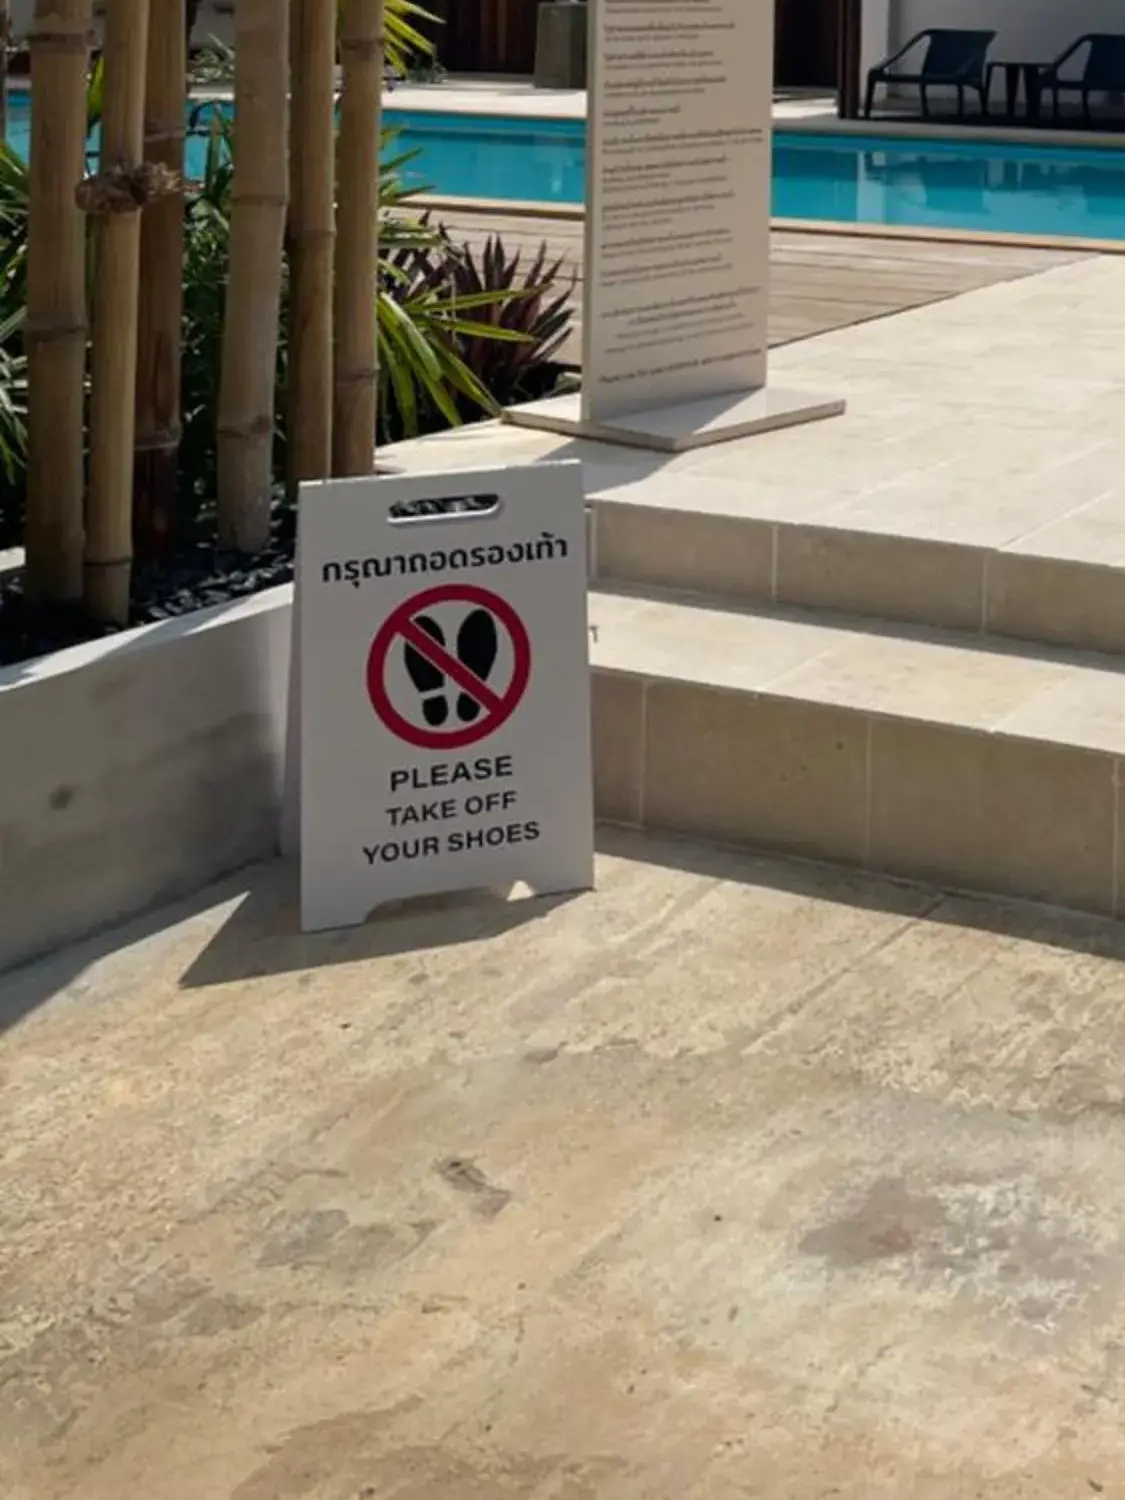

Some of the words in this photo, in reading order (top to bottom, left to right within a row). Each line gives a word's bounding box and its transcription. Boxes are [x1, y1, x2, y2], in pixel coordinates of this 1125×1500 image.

[322, 531, 568, 588] กรุณาถอดรองเท้า
[390, 755, 514, 792] PLEASE
[386, 798, 457, 827] TAKE
[465, 790, 517, 816] OFF
[362, 835, 439, 866] YOUR
[447, 821, 540, 854] SHOES
